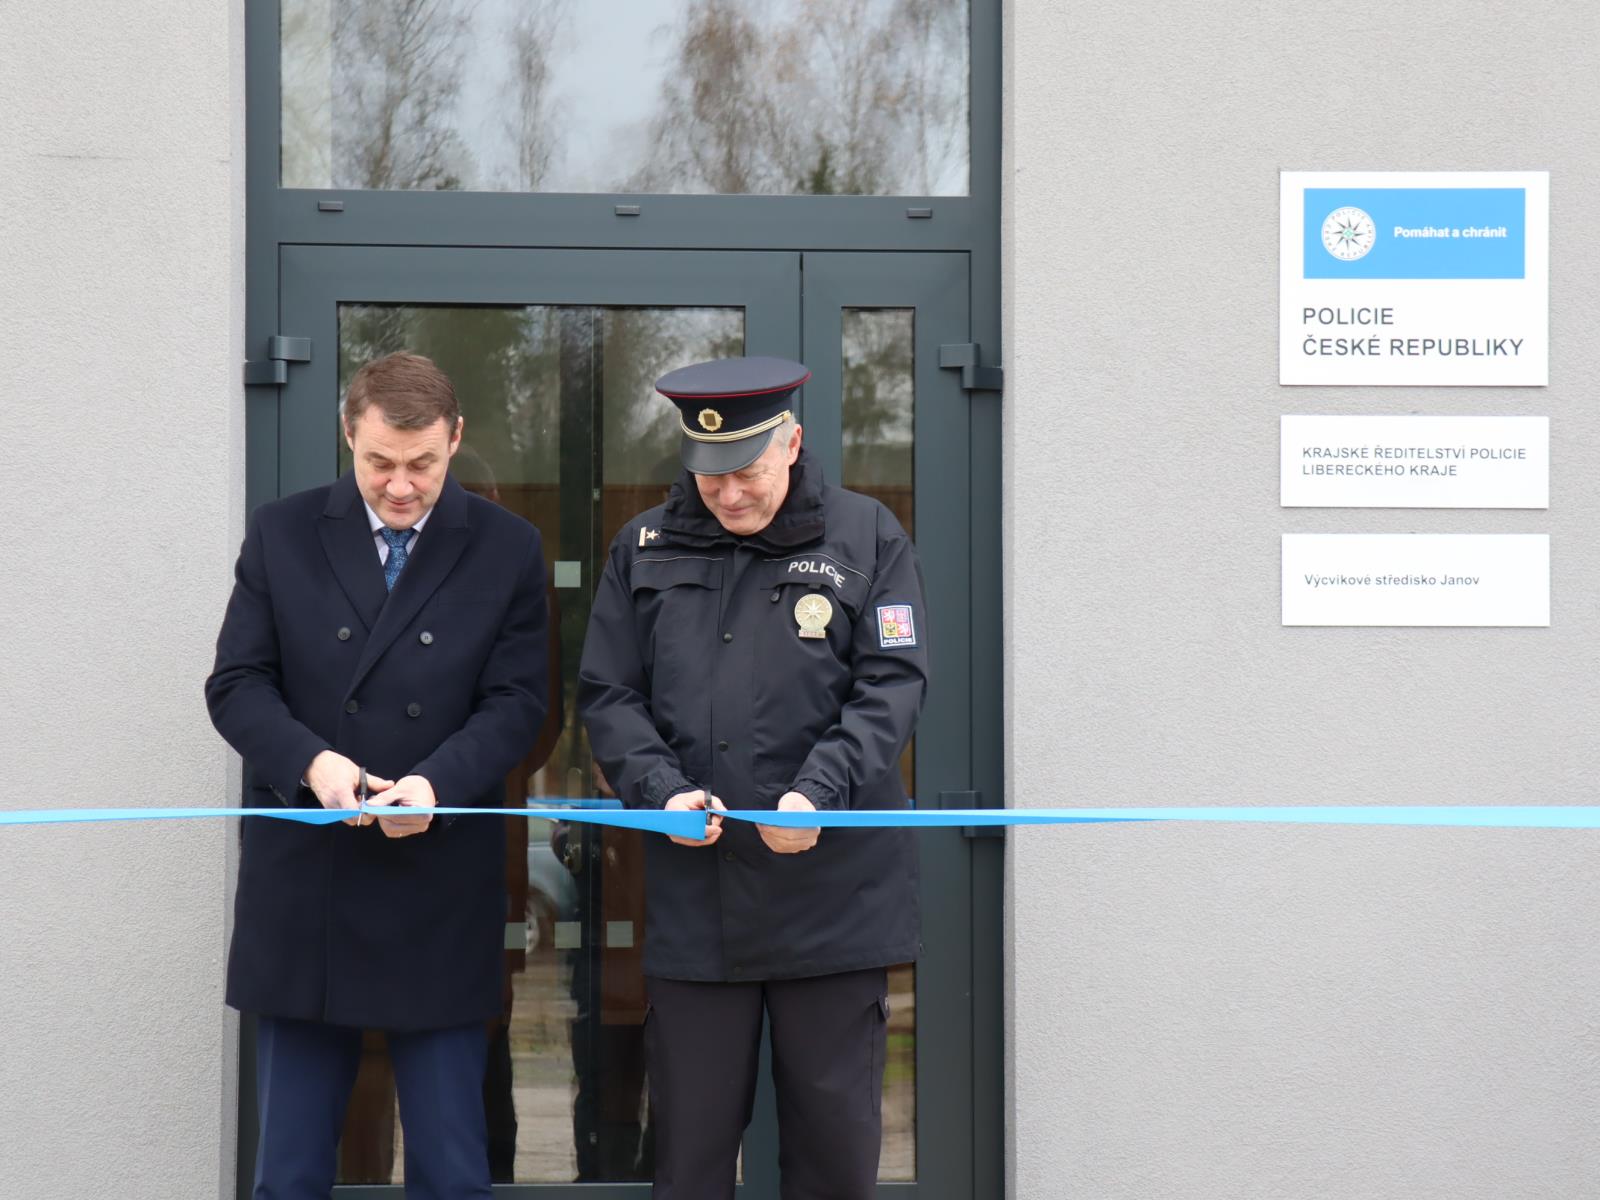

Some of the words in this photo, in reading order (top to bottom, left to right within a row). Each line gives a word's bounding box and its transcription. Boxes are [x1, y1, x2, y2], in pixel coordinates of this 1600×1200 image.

[1393, 226, 1450, 238] Pomáhat
[1452, 229, 1460, 238] a
[1462, 226, 1507, 238] chránit
[1303, 307, 1394, 325] POLICIE
[1303, 334, 1381, 356] ČESKÉ
[1389, 338, 1524, 356] REPUBLIKY
[1303, 444, 1369, 459] KRAJSKÉ
[1374, 444, 1466, 460] ŘEDITELSTVÍ
[1470, 448, 1527, 460] POLICIE
[1303, 462, 1406, 476] LIBERECKÉHO
[1410, 464, 1458, 477] KRAJE
[788, 561, 846, 588] POLICIE
[1304, 574, 1371, 588] Výcvikové
[1375, 574, 1437, 586] středisko
[1440, 574, 1480, 586] Janov
